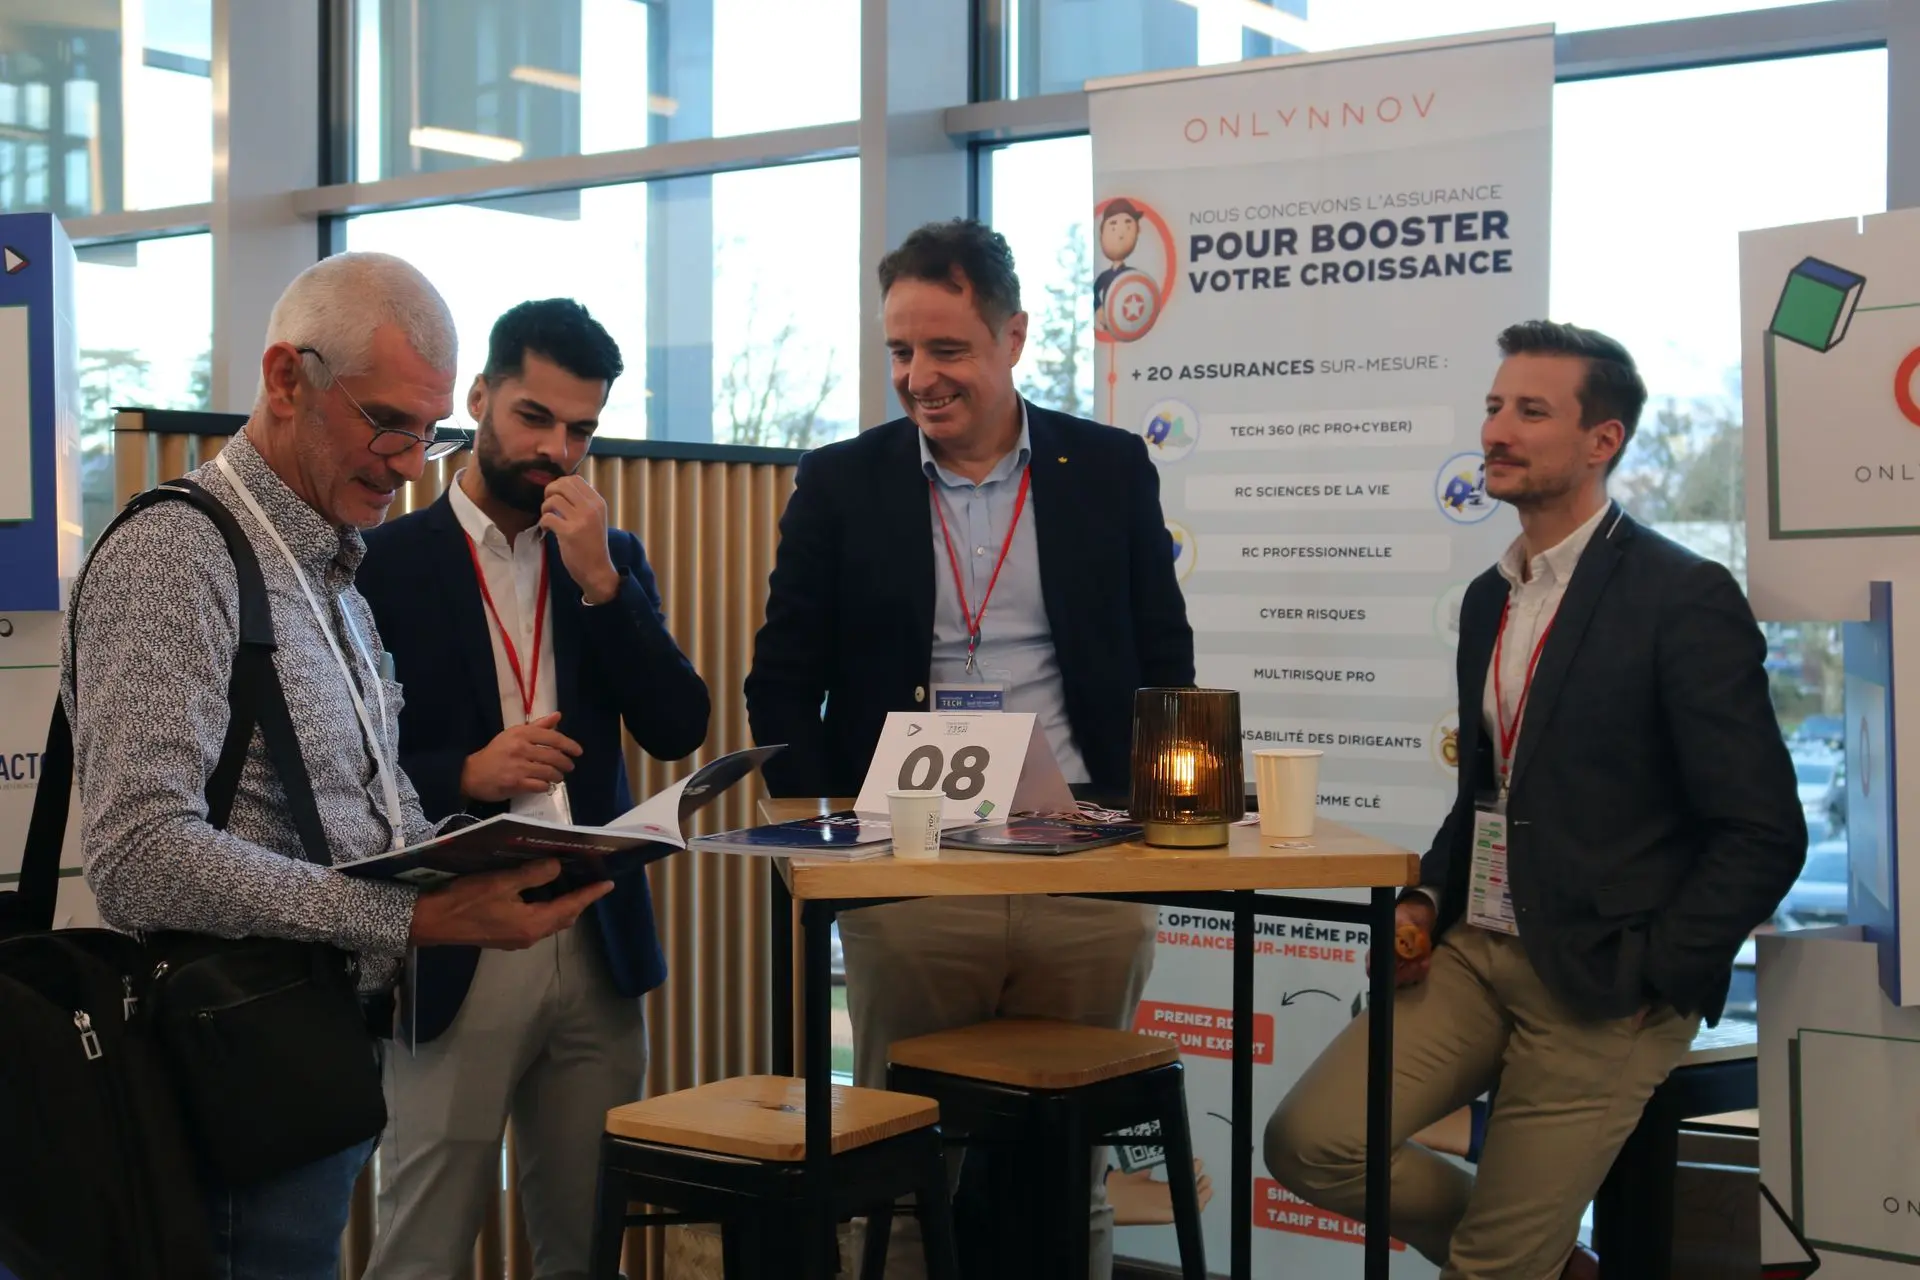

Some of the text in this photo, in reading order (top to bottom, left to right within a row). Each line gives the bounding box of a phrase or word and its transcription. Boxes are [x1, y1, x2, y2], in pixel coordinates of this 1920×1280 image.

[1184, 92, 1436, 143] ONLYNNOV
[1189, 185, 1504, 225] NOUS CONCEVONS L'ASSURANCE
[1189, 210, 1510, 263] POUR BOOSTER
[1188, 249, 1513, 293] VOTRE CROISSANCE
[1147, 365, 1173, 381] 20
[1179, 359, 1315, 380] ASSURANCES
[1320, 355, 1440, 374] SUR-MESURE
[1231, 420, 1412, 437] TECH 360 (RC PRO+CYBER)
[1855, 464, 1920, 483] ONL
[1235, 484, 1390, 498] RC SCIENCES DE LA VIE
[1242, 546, 1392, 558] RC PROFESSIONNELLE
[1260, 608, 1366, 621] CYBER RISQUES
[1254, 668, 1375, 683] MULTIRISQUE PRO
[1241, 729, 1422, 748] NSABILITÉ DES DIRIGEANTS
[898, 745, 990, 800] 08
[1354, 795, 1381, 808] CLÉ
[1254, 921, 1286, 937] UNE
[1291, 923, 1340, 942] MÊME
[1346, 930, 1369, 945] PR
[1157, 931, 1356, 963] SURANCE UR-MESURE
[1154, 1009, 1213, 1028] PRENEZ
[1181, 1033, 1202, 1047] UN
[1206, 1036, 1266, 1055] EXPT
[1267, 1208, 1366, 1237] TARIF EN LIG
